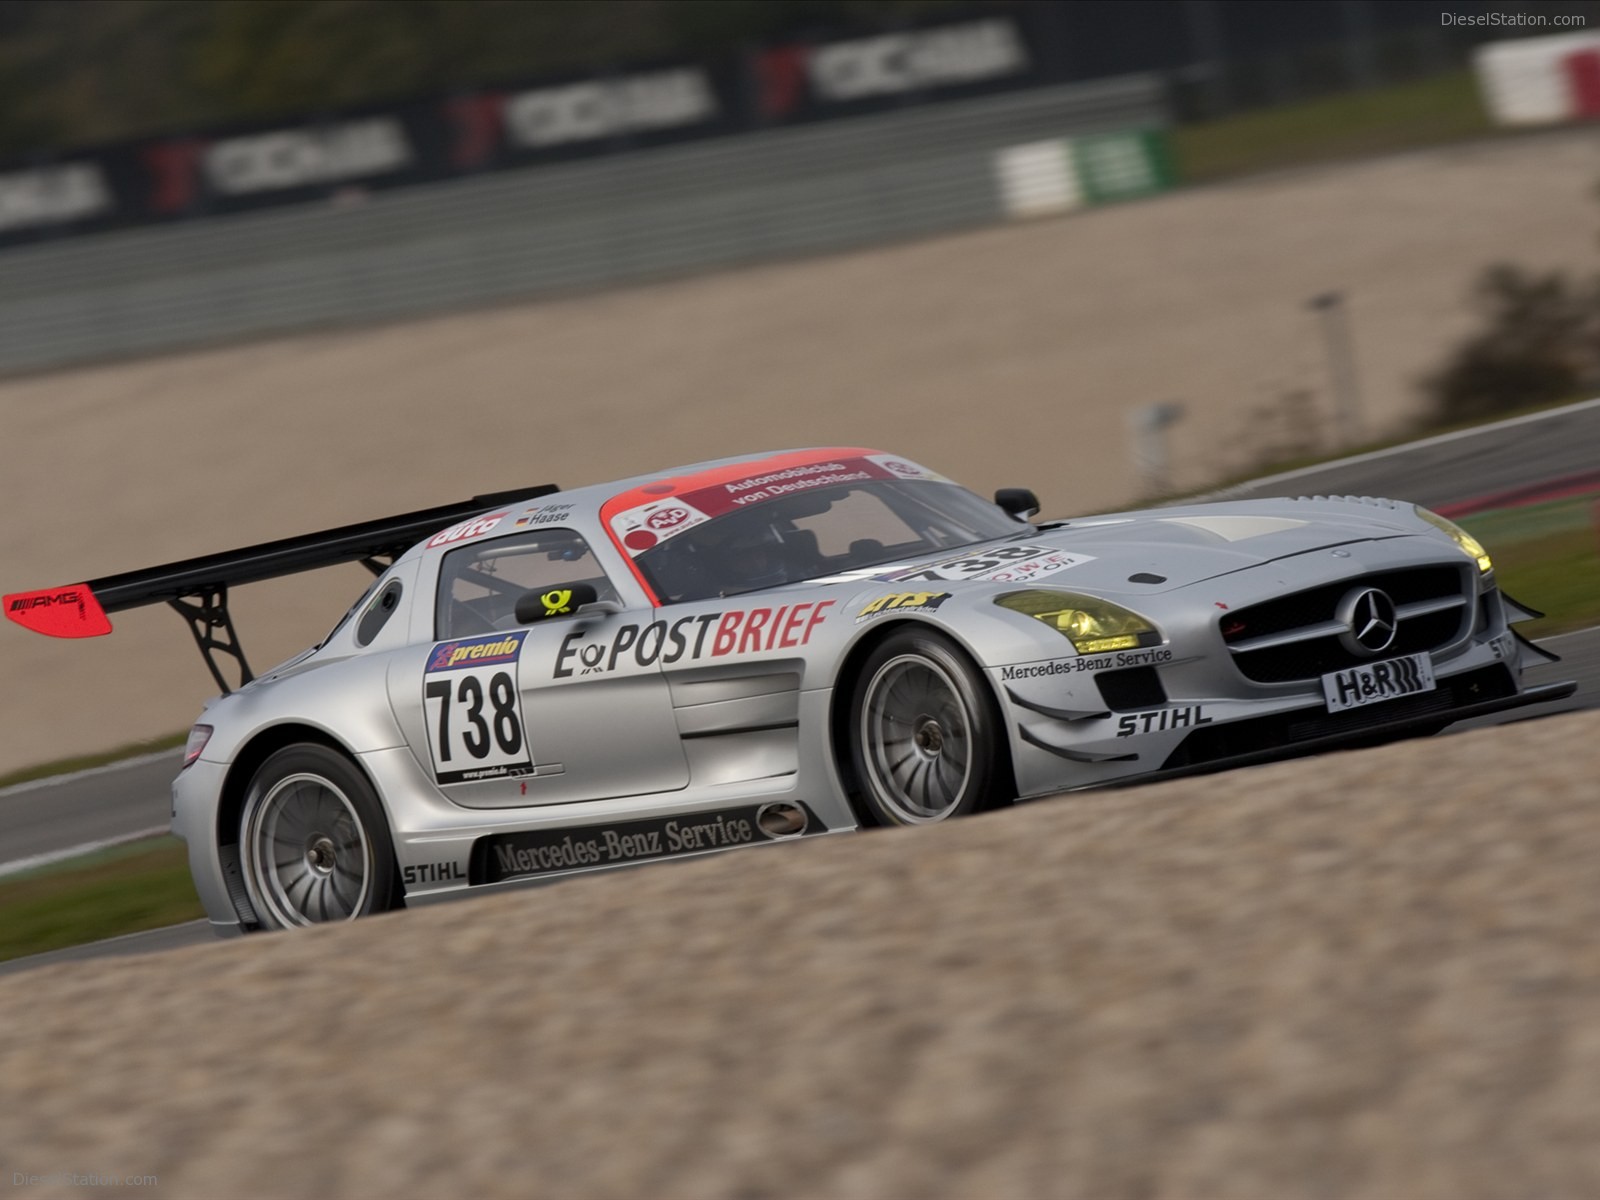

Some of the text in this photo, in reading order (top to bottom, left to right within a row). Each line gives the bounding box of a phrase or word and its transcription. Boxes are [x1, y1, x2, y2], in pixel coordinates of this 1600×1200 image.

[724, 463, 846, 493] Automobilclub
[733, 470, 873, 506] von Deutschland
[529, 512, 570, 525] Haase
[651, 508, 687, 530] AvD
[896, 547, 1041, 582] 738
[31, 592, 80, 608] AMG
[448, 636, 519, 666] premio
[1001, 650, 1173, 681] Mercedes-Benz Service
[1336, 662, 1398, 706] H&R
[426, 671, 522, 762] 738
[1117, 705, 1213, 738] STIHL
[404, 815, 753, 884] STIHL Mercedes-Benz Service
